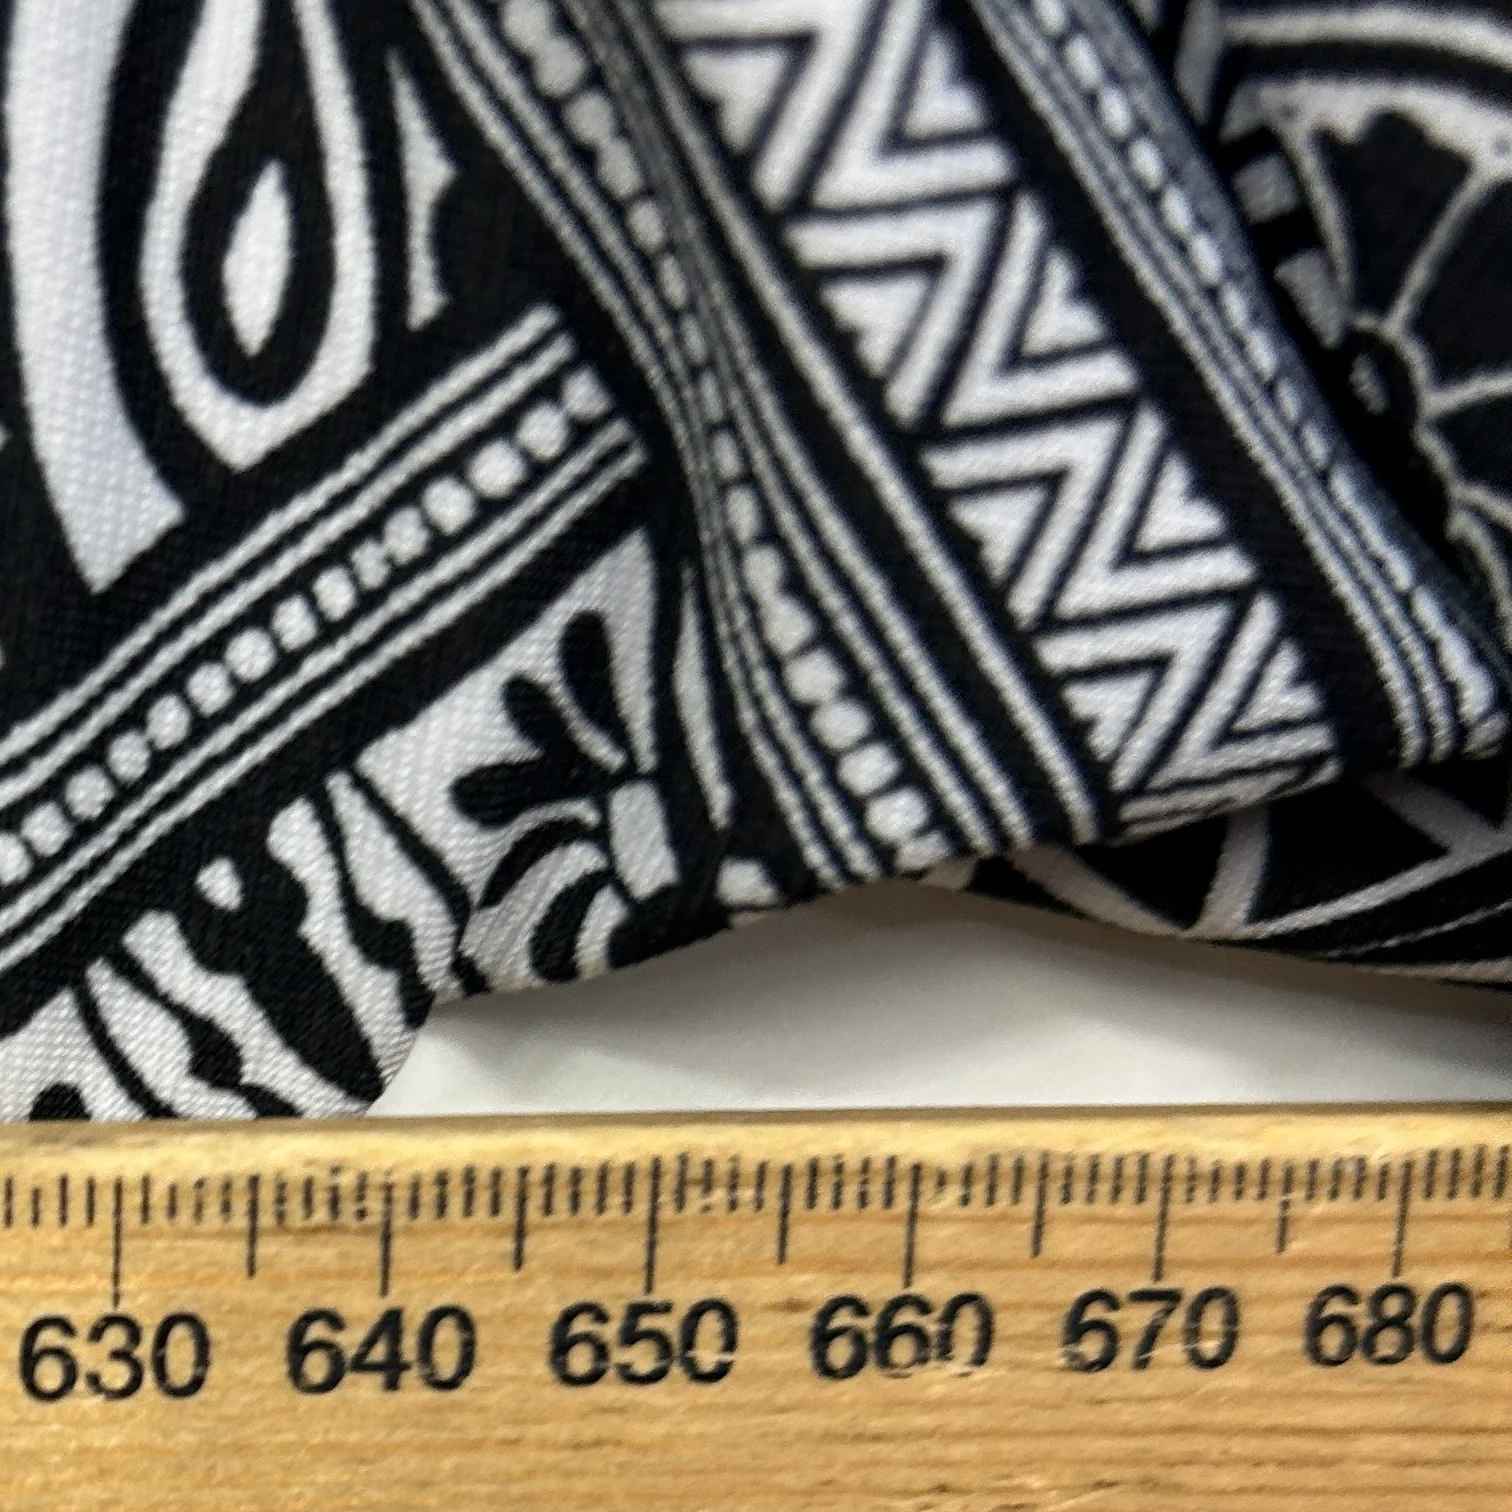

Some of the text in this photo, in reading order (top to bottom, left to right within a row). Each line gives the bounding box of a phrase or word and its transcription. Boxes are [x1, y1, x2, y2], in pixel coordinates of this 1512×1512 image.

[19, 1312, 211, 1402] 630
[286, 1305, 477, 1394] 640
[548, 1298, 739, 1387] 650
[809, 1292, 995, 1380] 660
[1062, 1286, 1241, 1373] 670
[1304, 1282, 1476, 1367] 680
